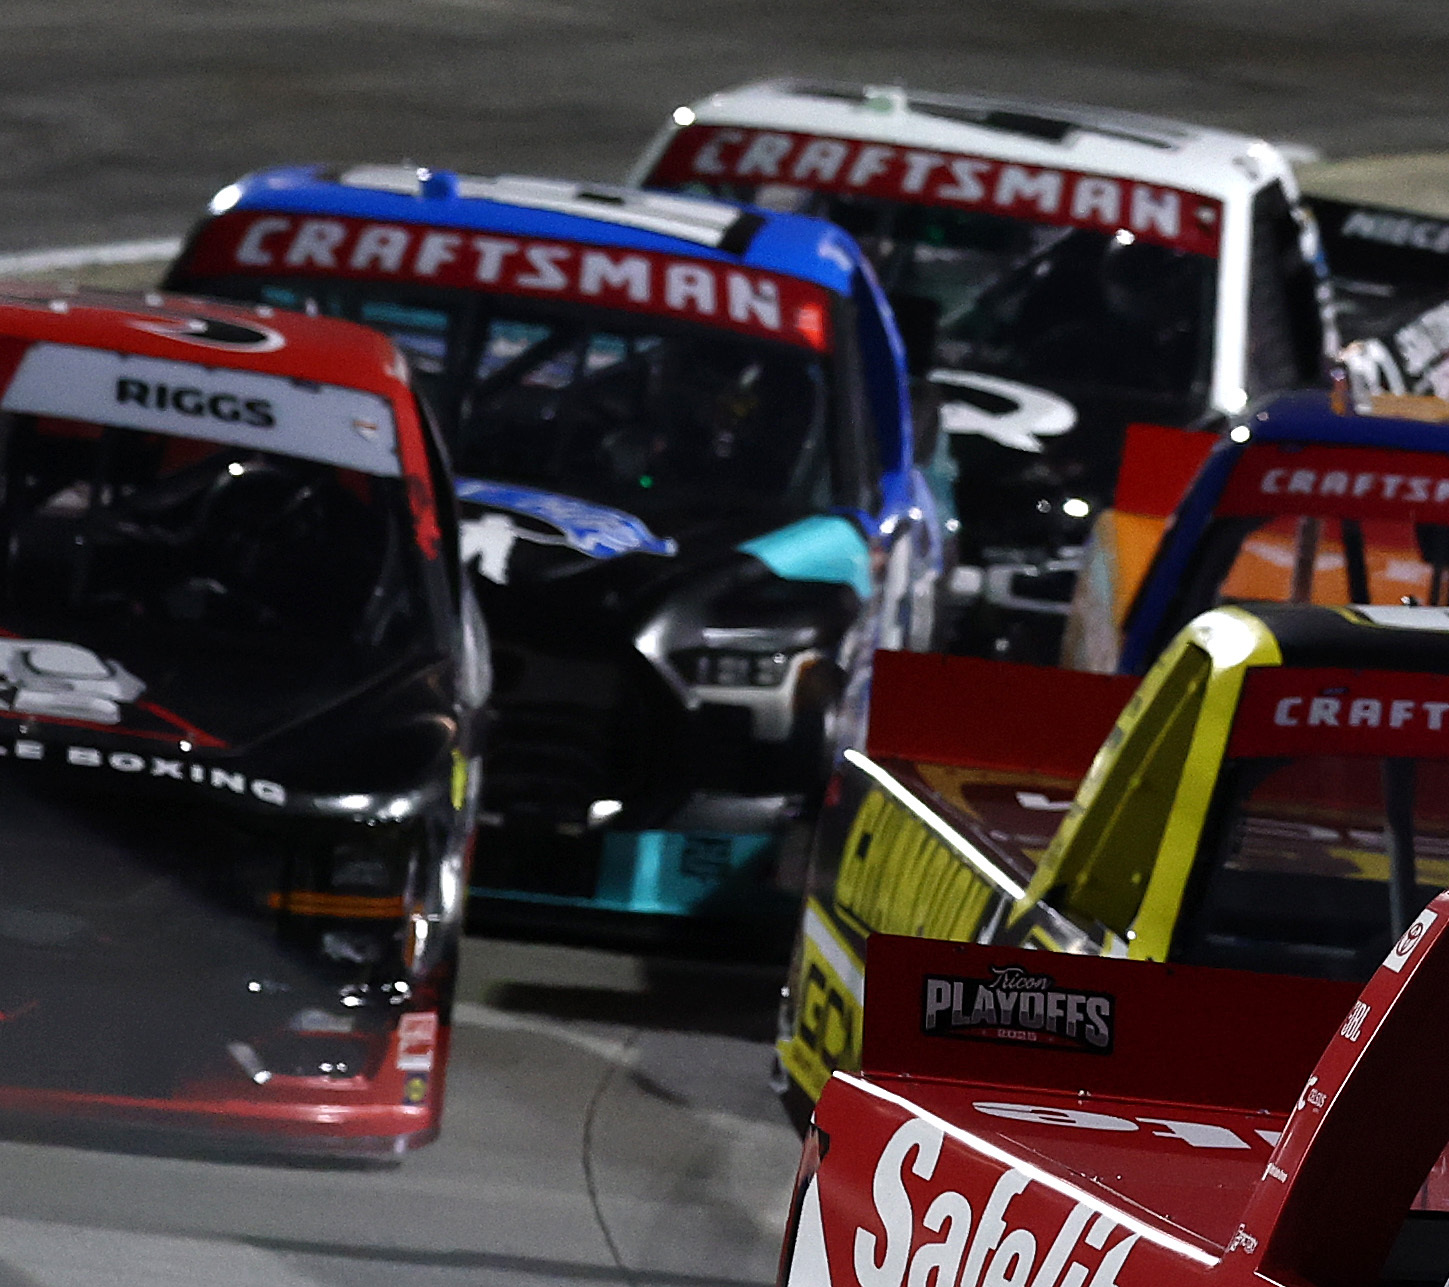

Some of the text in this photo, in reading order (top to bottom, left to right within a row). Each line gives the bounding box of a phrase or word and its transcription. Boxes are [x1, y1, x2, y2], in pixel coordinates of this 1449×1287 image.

[692, 125, 1184, 239] CRAFTSMAN
[235, 217, 784, 334] CRAFTSMAN
[115, 377, 278, 430] RIGGS
[66, 743, 288, 807] BOXING
[924, 976, 1112, 1049] PLAYOFFS
